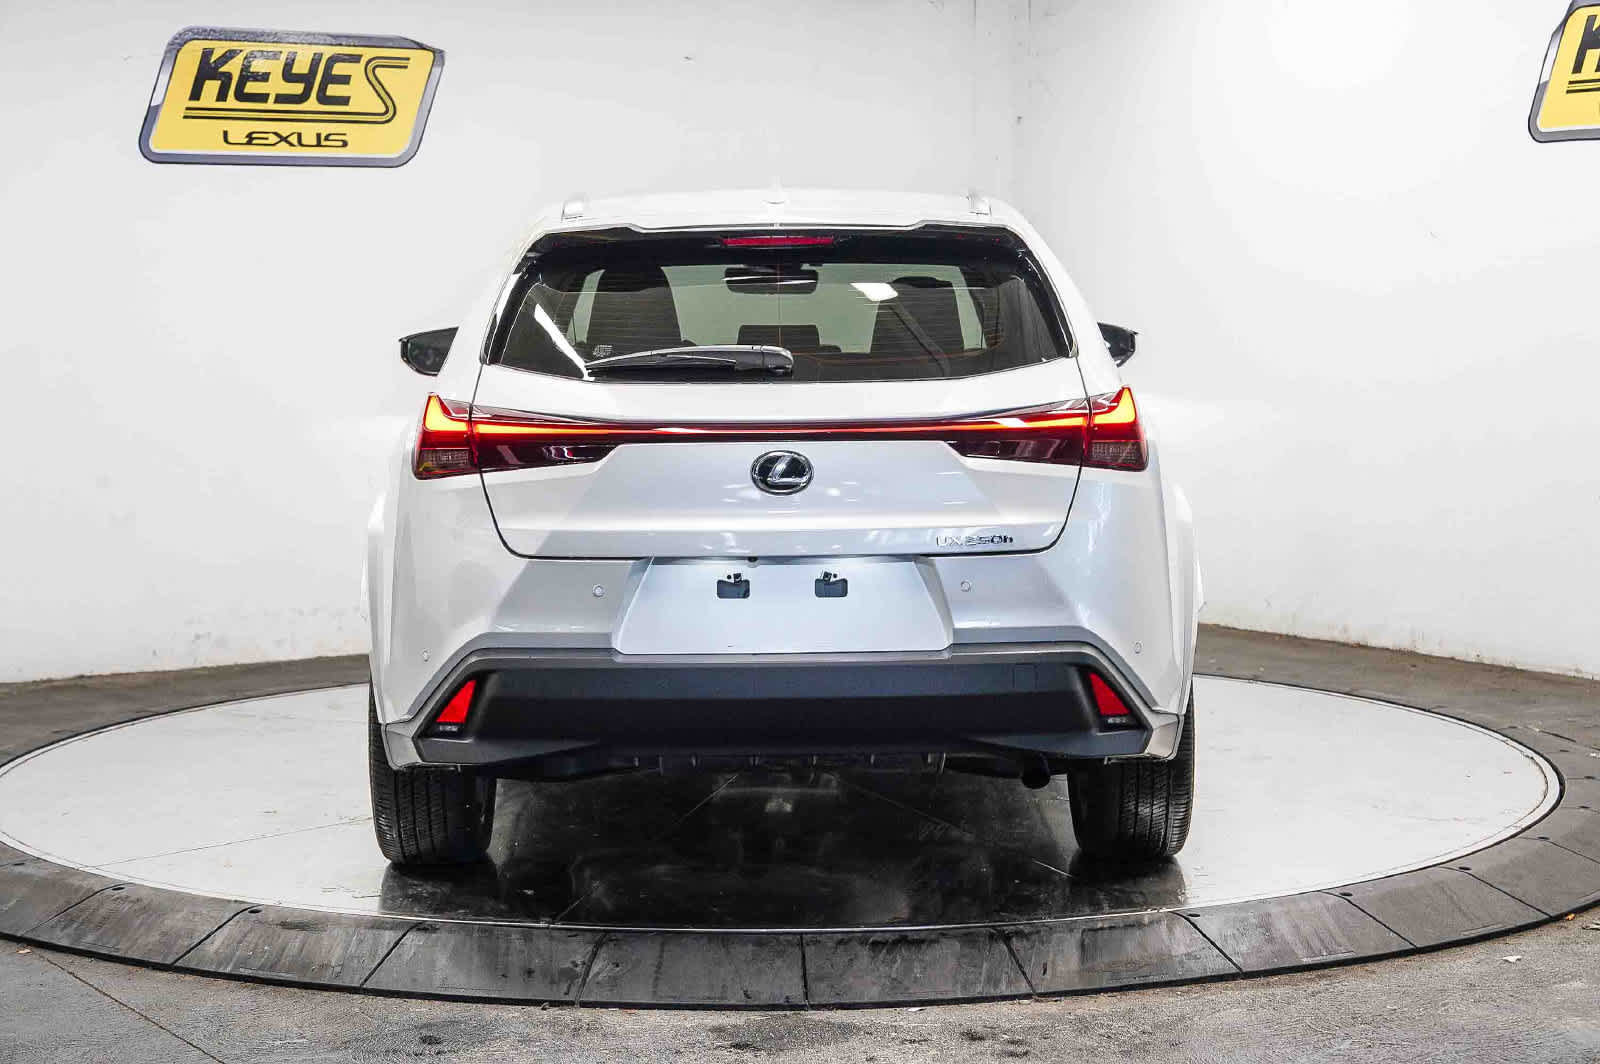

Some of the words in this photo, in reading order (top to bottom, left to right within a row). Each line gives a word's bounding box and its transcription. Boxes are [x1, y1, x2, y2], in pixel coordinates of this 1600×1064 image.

[184, 47, 410, 124] KEYES
[223, 130, 349, 148] LEXUS
[936, 535, 963, 546] UX
